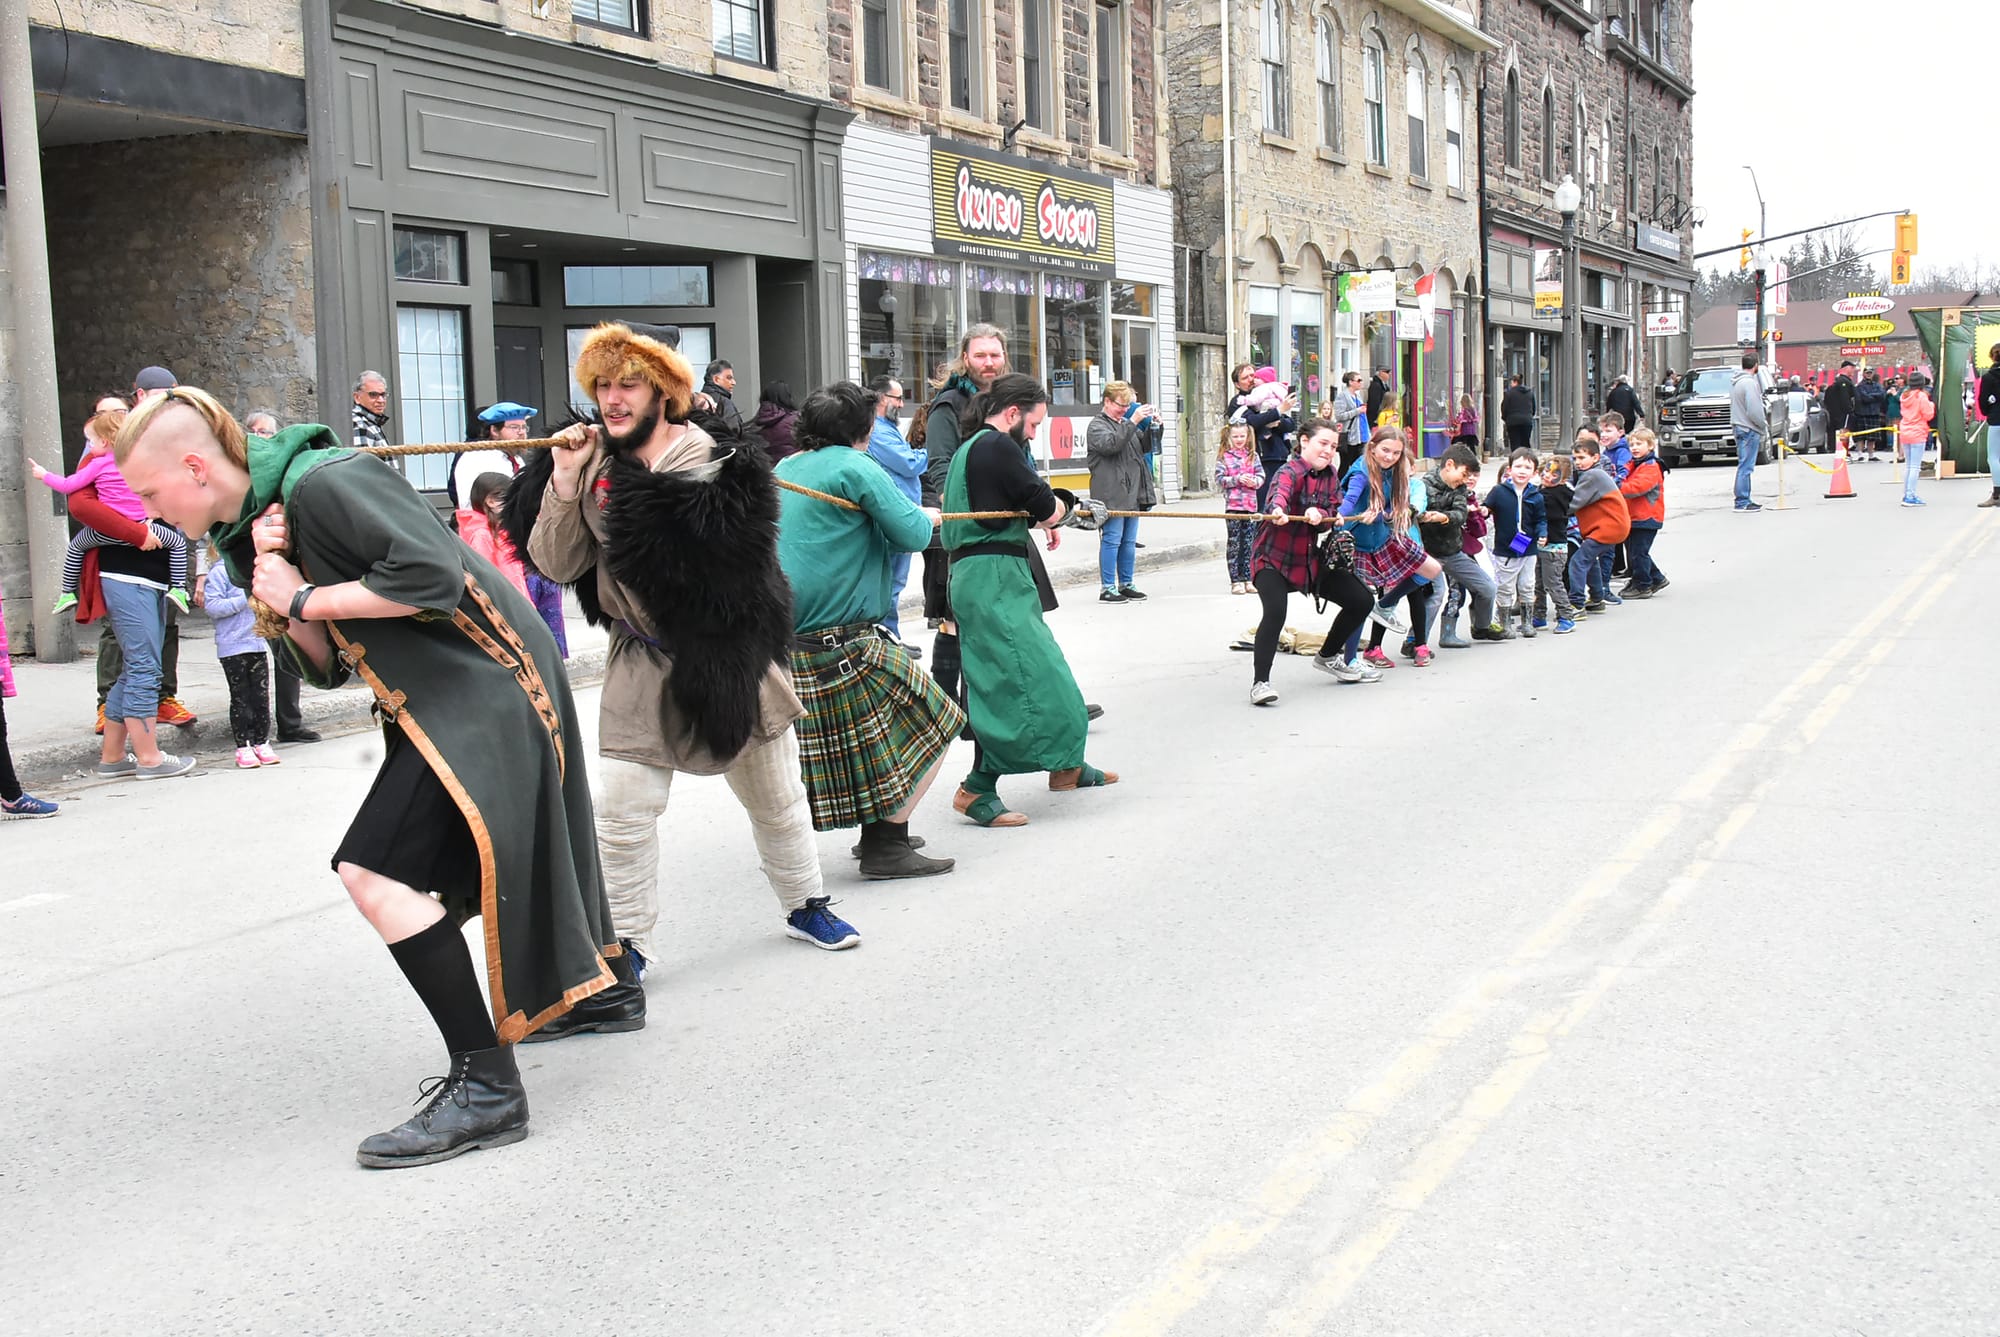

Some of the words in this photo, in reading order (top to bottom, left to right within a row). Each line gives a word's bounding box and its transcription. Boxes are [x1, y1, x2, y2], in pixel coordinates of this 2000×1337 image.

[959, 245, 986, 256] JAPANESE
[987, 249, 1019, 260] RESTAURANT
[1837, 301, 1854, 312] Tim
[1855, 300, 1891, 311] Hortons
[1835, 324, 1864, 333] ALWAYS
[1865, 324, 1890, 332] FRESH
[1054, 372, 1072, 381] OPEN
